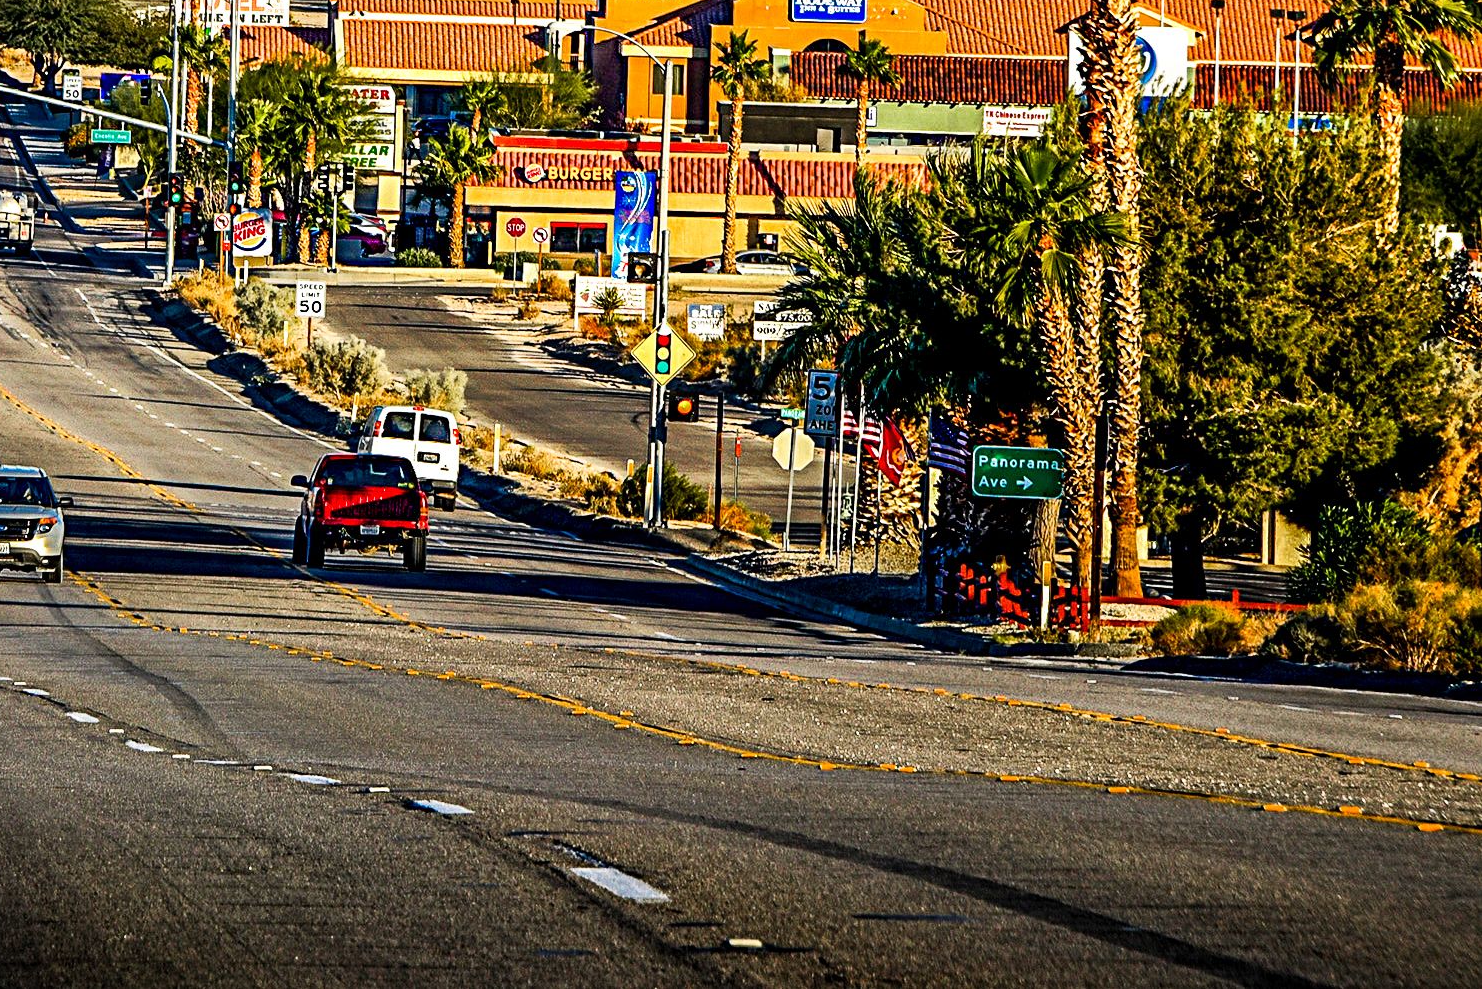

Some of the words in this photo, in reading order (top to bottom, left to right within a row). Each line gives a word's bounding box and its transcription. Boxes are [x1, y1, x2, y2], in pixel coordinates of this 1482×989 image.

[252, 14, 284, 24] LEFT
[66, 90, 79, 98] 50
[1022, 112, 1048, 120] Express
[548, 166, 614, 181] BURGER
[233, 217, 264, 232] BURGER
[508, 224, 524, 232] STOP
[234, 225, 266, 243] KING
[300, 300, 322, 314] 50
[812, 376, 831, 400] 5
[816, 404, 836, 416] ZO
[810, 419, 834, 430] AHE
[979, 456, 1058, 470] Panorama
[979, 476, 1008, 488] Ave
